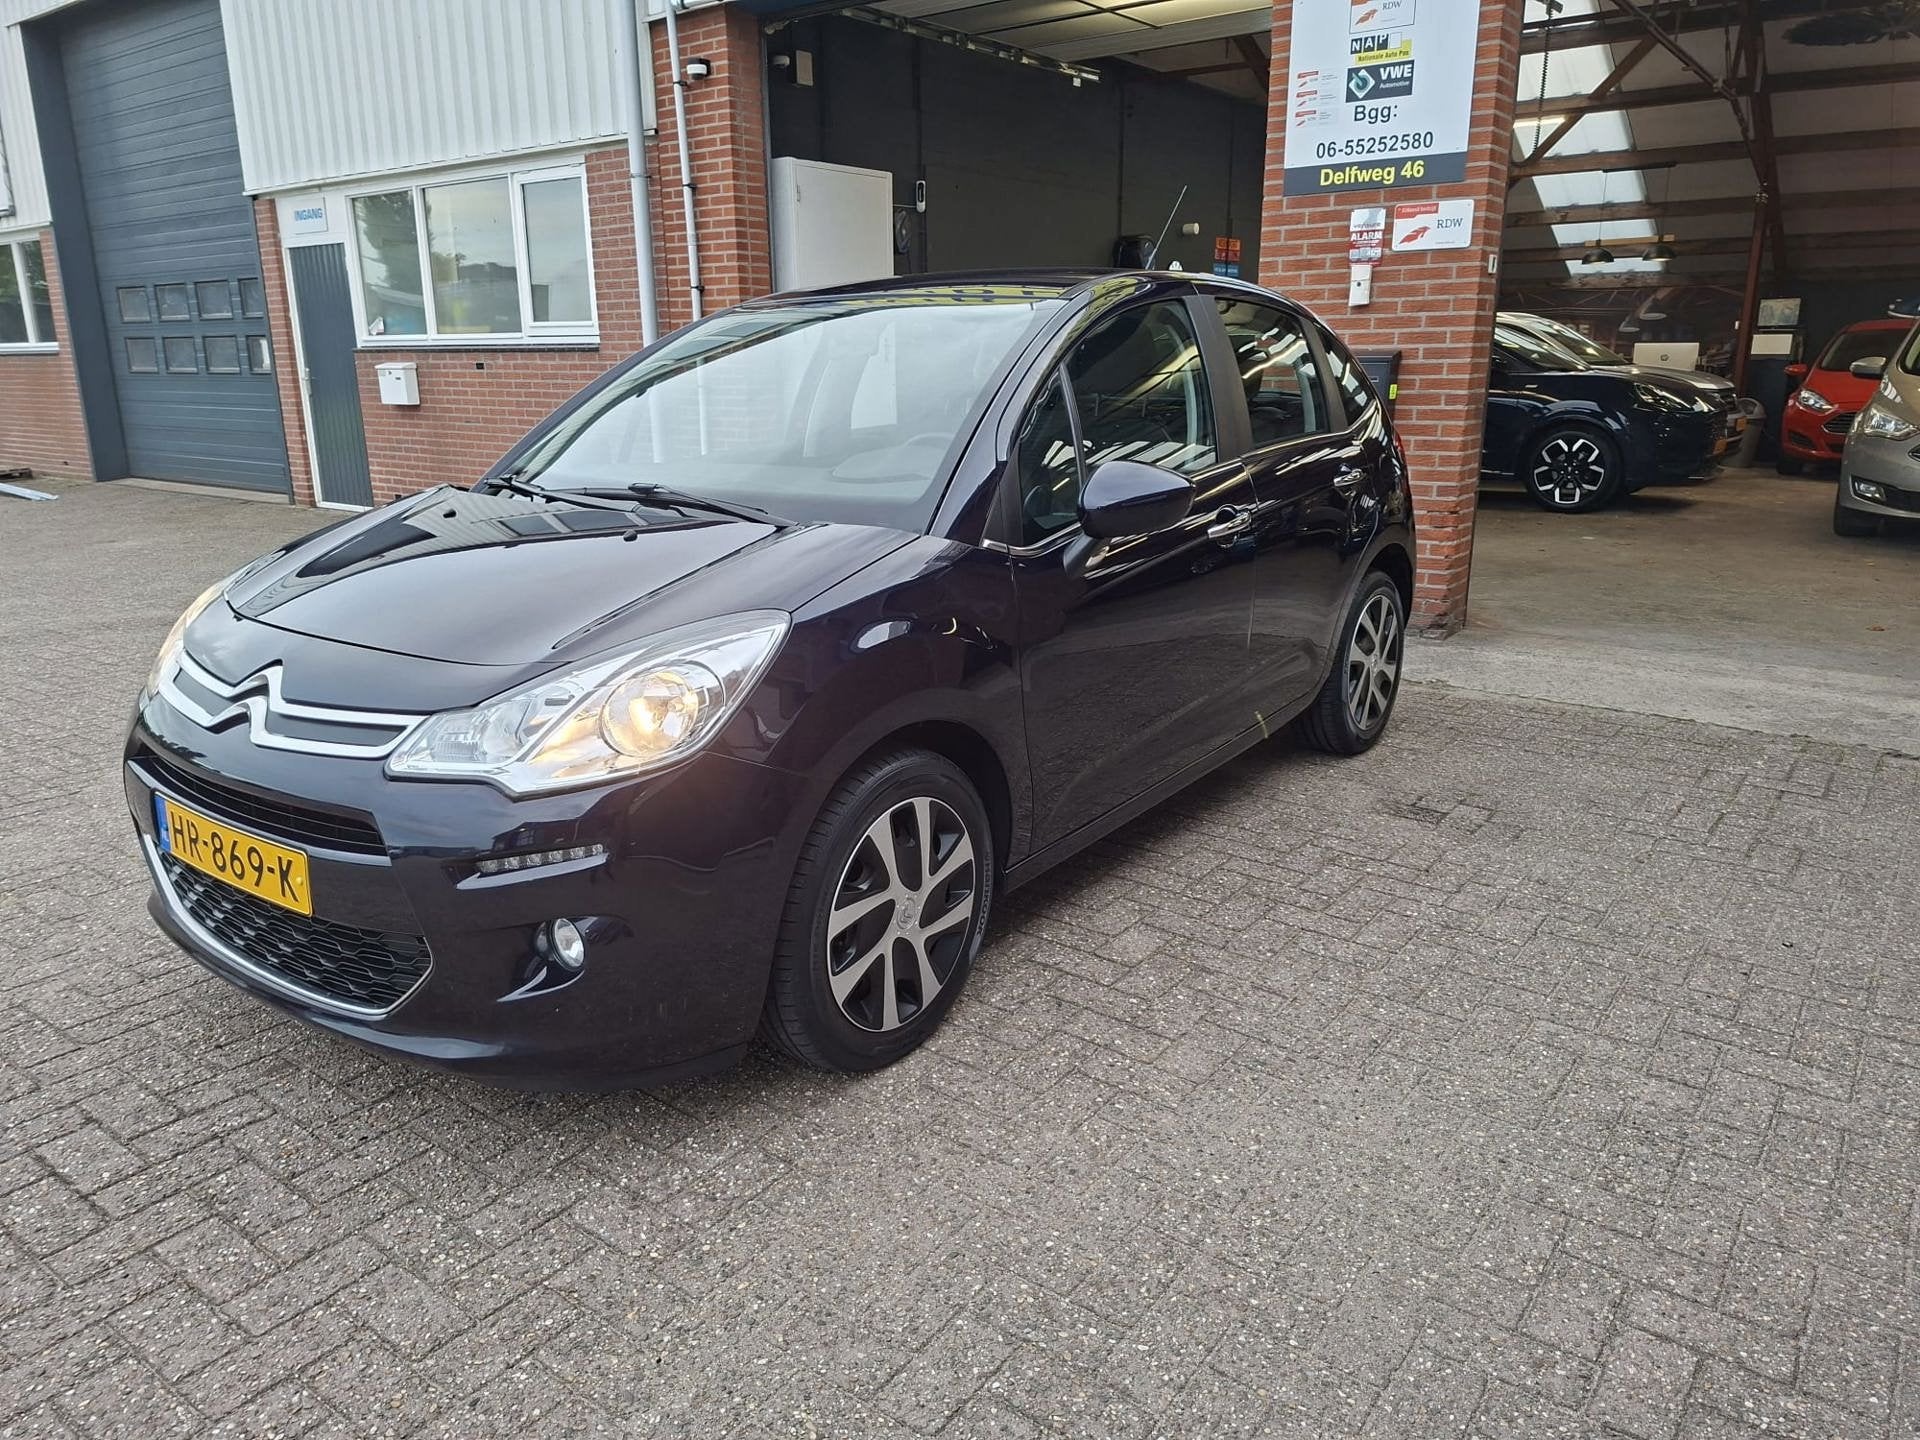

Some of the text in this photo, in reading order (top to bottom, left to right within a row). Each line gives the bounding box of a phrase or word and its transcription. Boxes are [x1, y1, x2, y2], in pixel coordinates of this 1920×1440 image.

[1351, 34, 1388, 52] NAP
[1380, 64, 1412, 80] VWE
[1354, 104, 1398, 124] Bgg:
[1316, 131, 1434, 159] 06-55252580
[1320, 160, 1425, 186] Delfweg 46
[294, 208, 323, 221] INGANG
[1437, 218, 1463, 229] RDW
[1351, 231, 1383, 241] ALARM
[170, 810, 299, 903] HR-869-K
